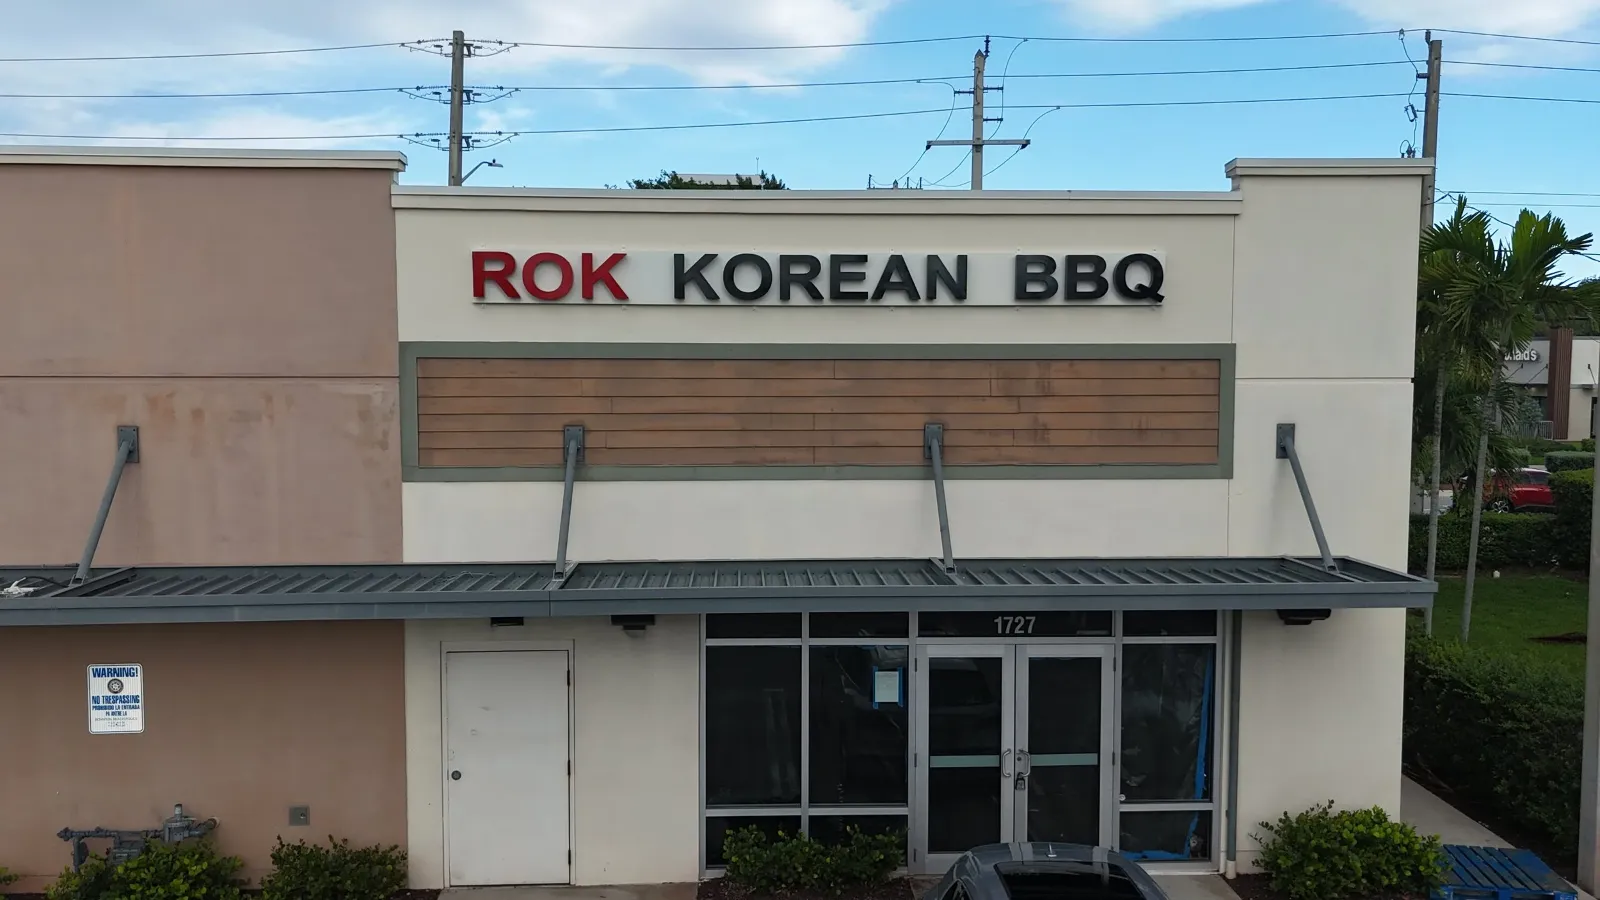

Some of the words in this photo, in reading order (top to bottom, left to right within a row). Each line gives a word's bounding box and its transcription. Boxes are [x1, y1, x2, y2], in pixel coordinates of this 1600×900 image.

[472, 251, 629, 301] ROK
[673, 253, 967, 301] KOREAN
[1015, 253, 1165, 303] BBQ
[994, 616, 1036, 634] 1727
[92, 667, 138, 678] WARNING!
[92, 695, 101, 704] NO
[102, 695, 140, 704] TRESPASSING
